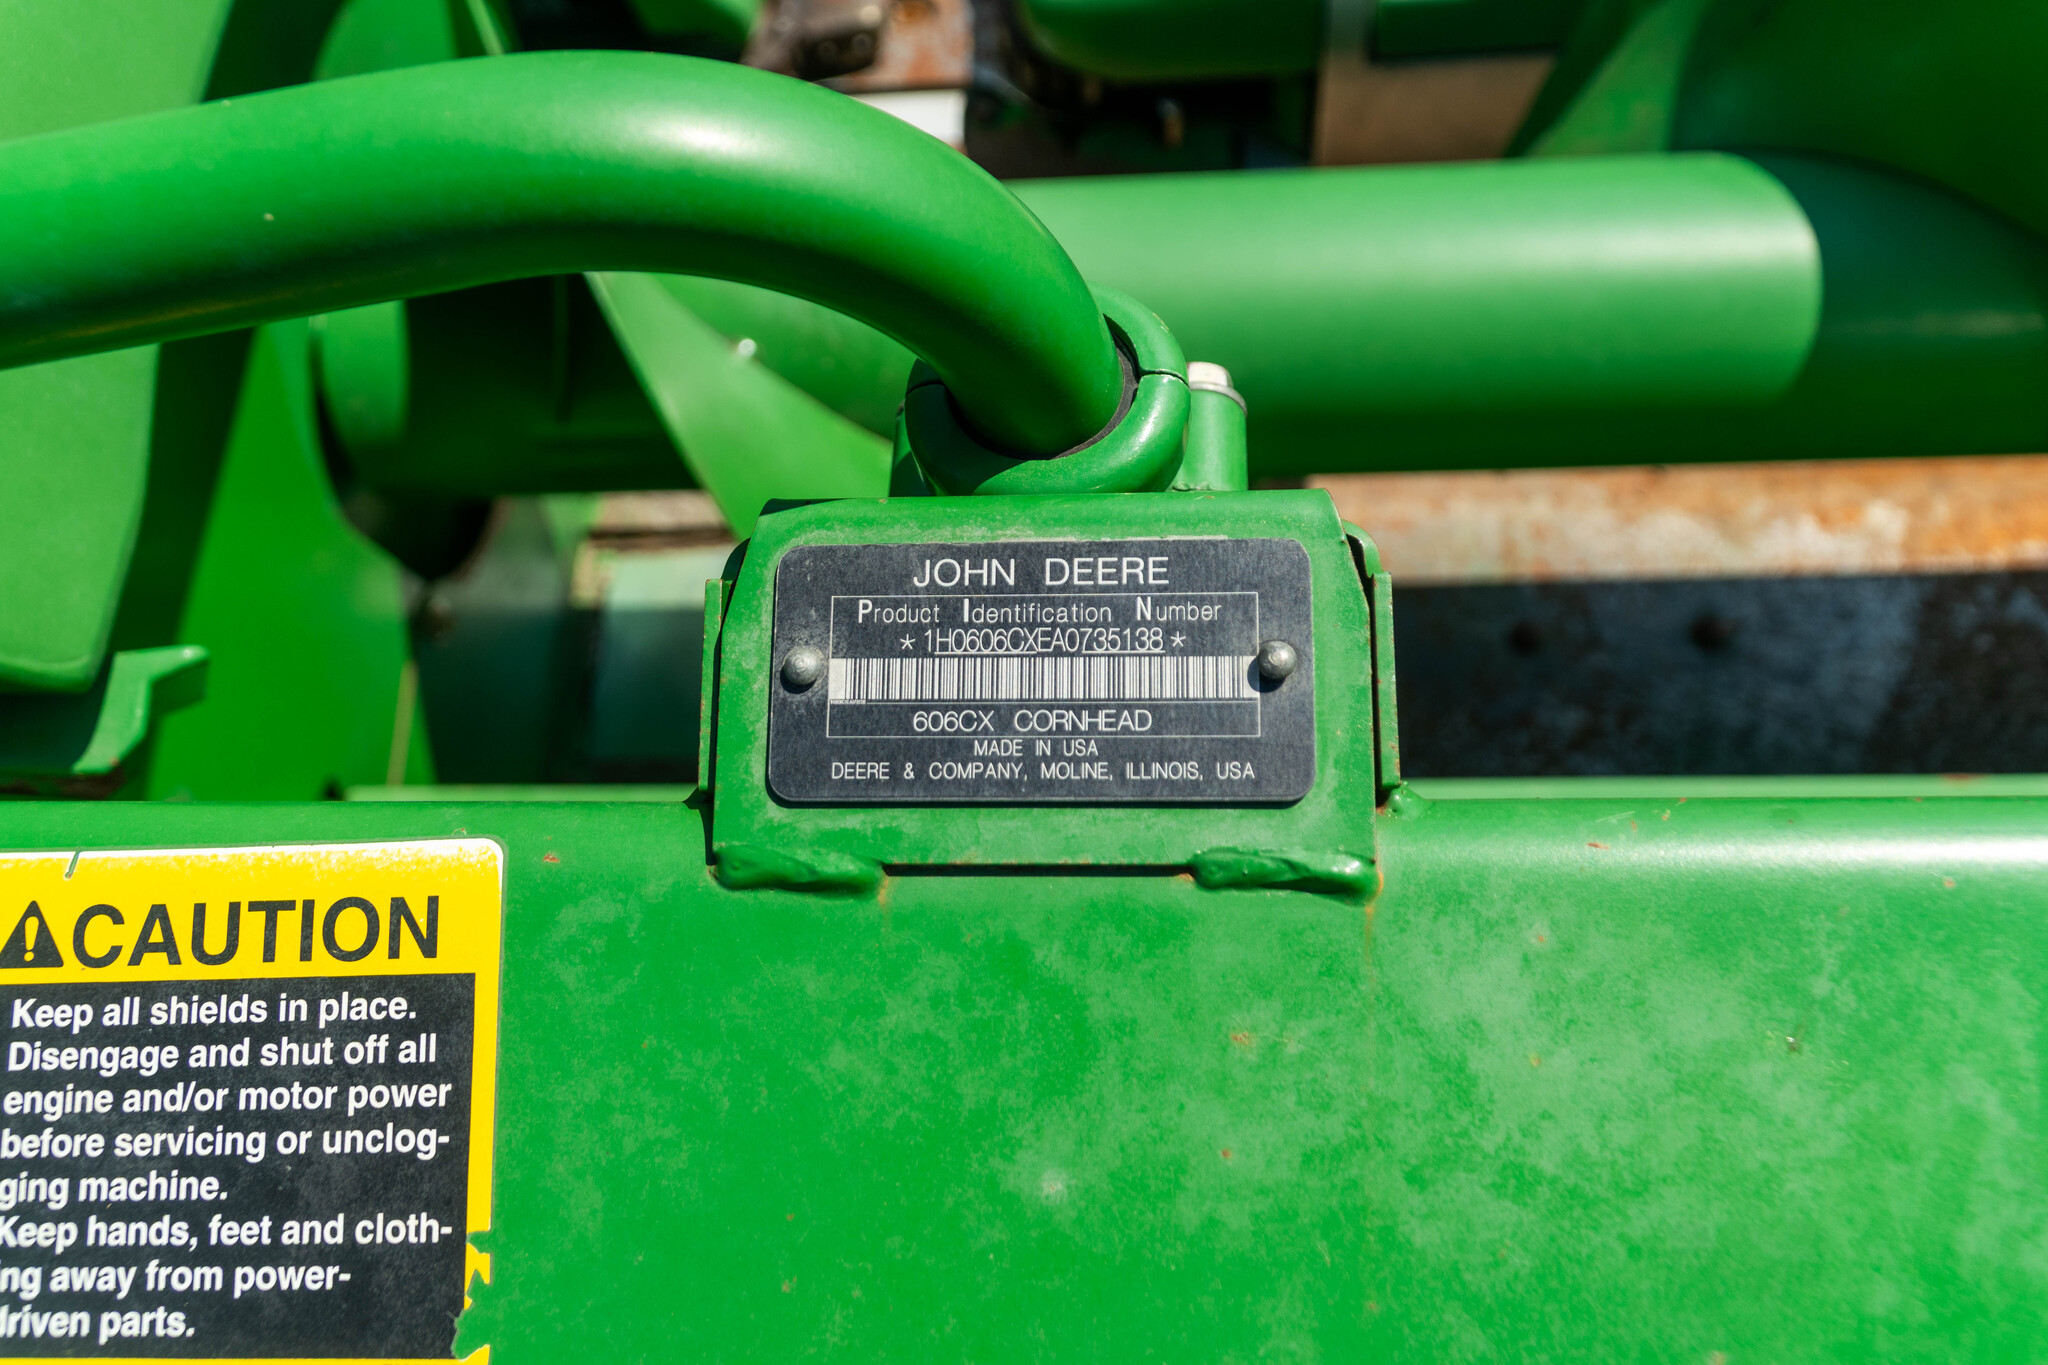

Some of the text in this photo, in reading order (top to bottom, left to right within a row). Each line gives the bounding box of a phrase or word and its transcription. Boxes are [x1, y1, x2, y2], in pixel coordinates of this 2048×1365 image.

[913, 557, 1169, 587] JOHN DEERE
[858, 596, 1222, 623] Product Identification Number
[925, 627, 1164, 653] 1H0606CXEA0735138
[913, 709, 1152, 732] 606CX CORNHEAD
[974, 739, 1098, 756] MADE IN USA
[832, 761, 1255, 781] DEERE & COMPANY, MOLINE, ILLINOIS, USA
[74, 896, 438, 968] CAUTION
[12, 992, 416, 1034] Keep all shields in place.
[8, 1033, 436, 1077] Disengage and shut off all
[4, 1081, 452, 1121] engine and/or motor power
[1, 1122, 449, 1162] before servicing or unclog-
[0, 1170, 227, 1210] ging machine.
[0, 1212, 452, 1254] Keep hands, feet and cloth-
[0, 1258, 350, 1300] ng away from power-
[99, 1307, 194, 1345] parts.
